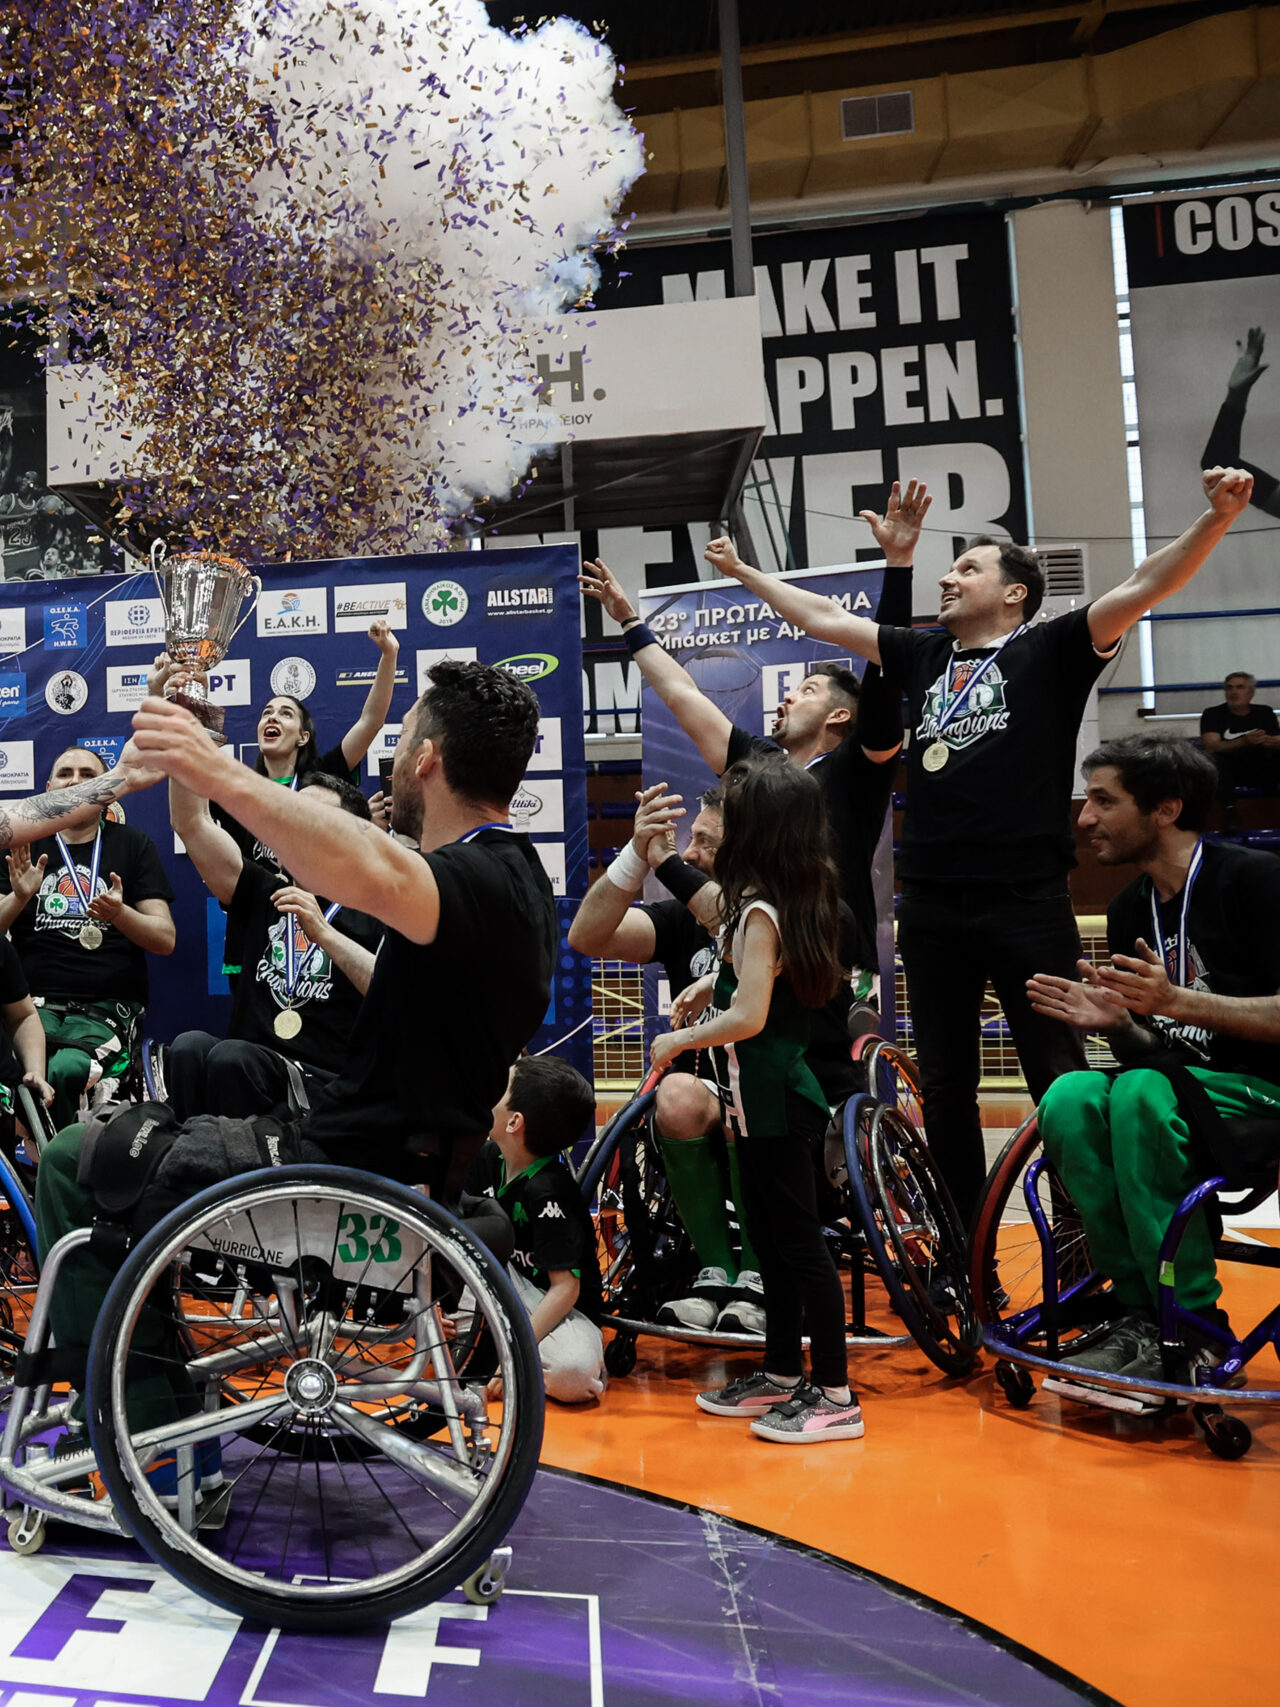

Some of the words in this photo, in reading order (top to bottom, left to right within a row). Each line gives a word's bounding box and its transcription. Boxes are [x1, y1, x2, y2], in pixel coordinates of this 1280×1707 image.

[894, 243, 969, 325] IT
[487, 588, 548, 607] ALLSTAR
[655, 630, 741, 650] Μπάσκετ
[747, 627, 770, 646] με
[502, 661, 545, 675] heel
[213, 1238, 284, 1265] HURRICANE
[338, 1213, 402, 1263] 33
[450, 1227, 488, 1268] KENDA
